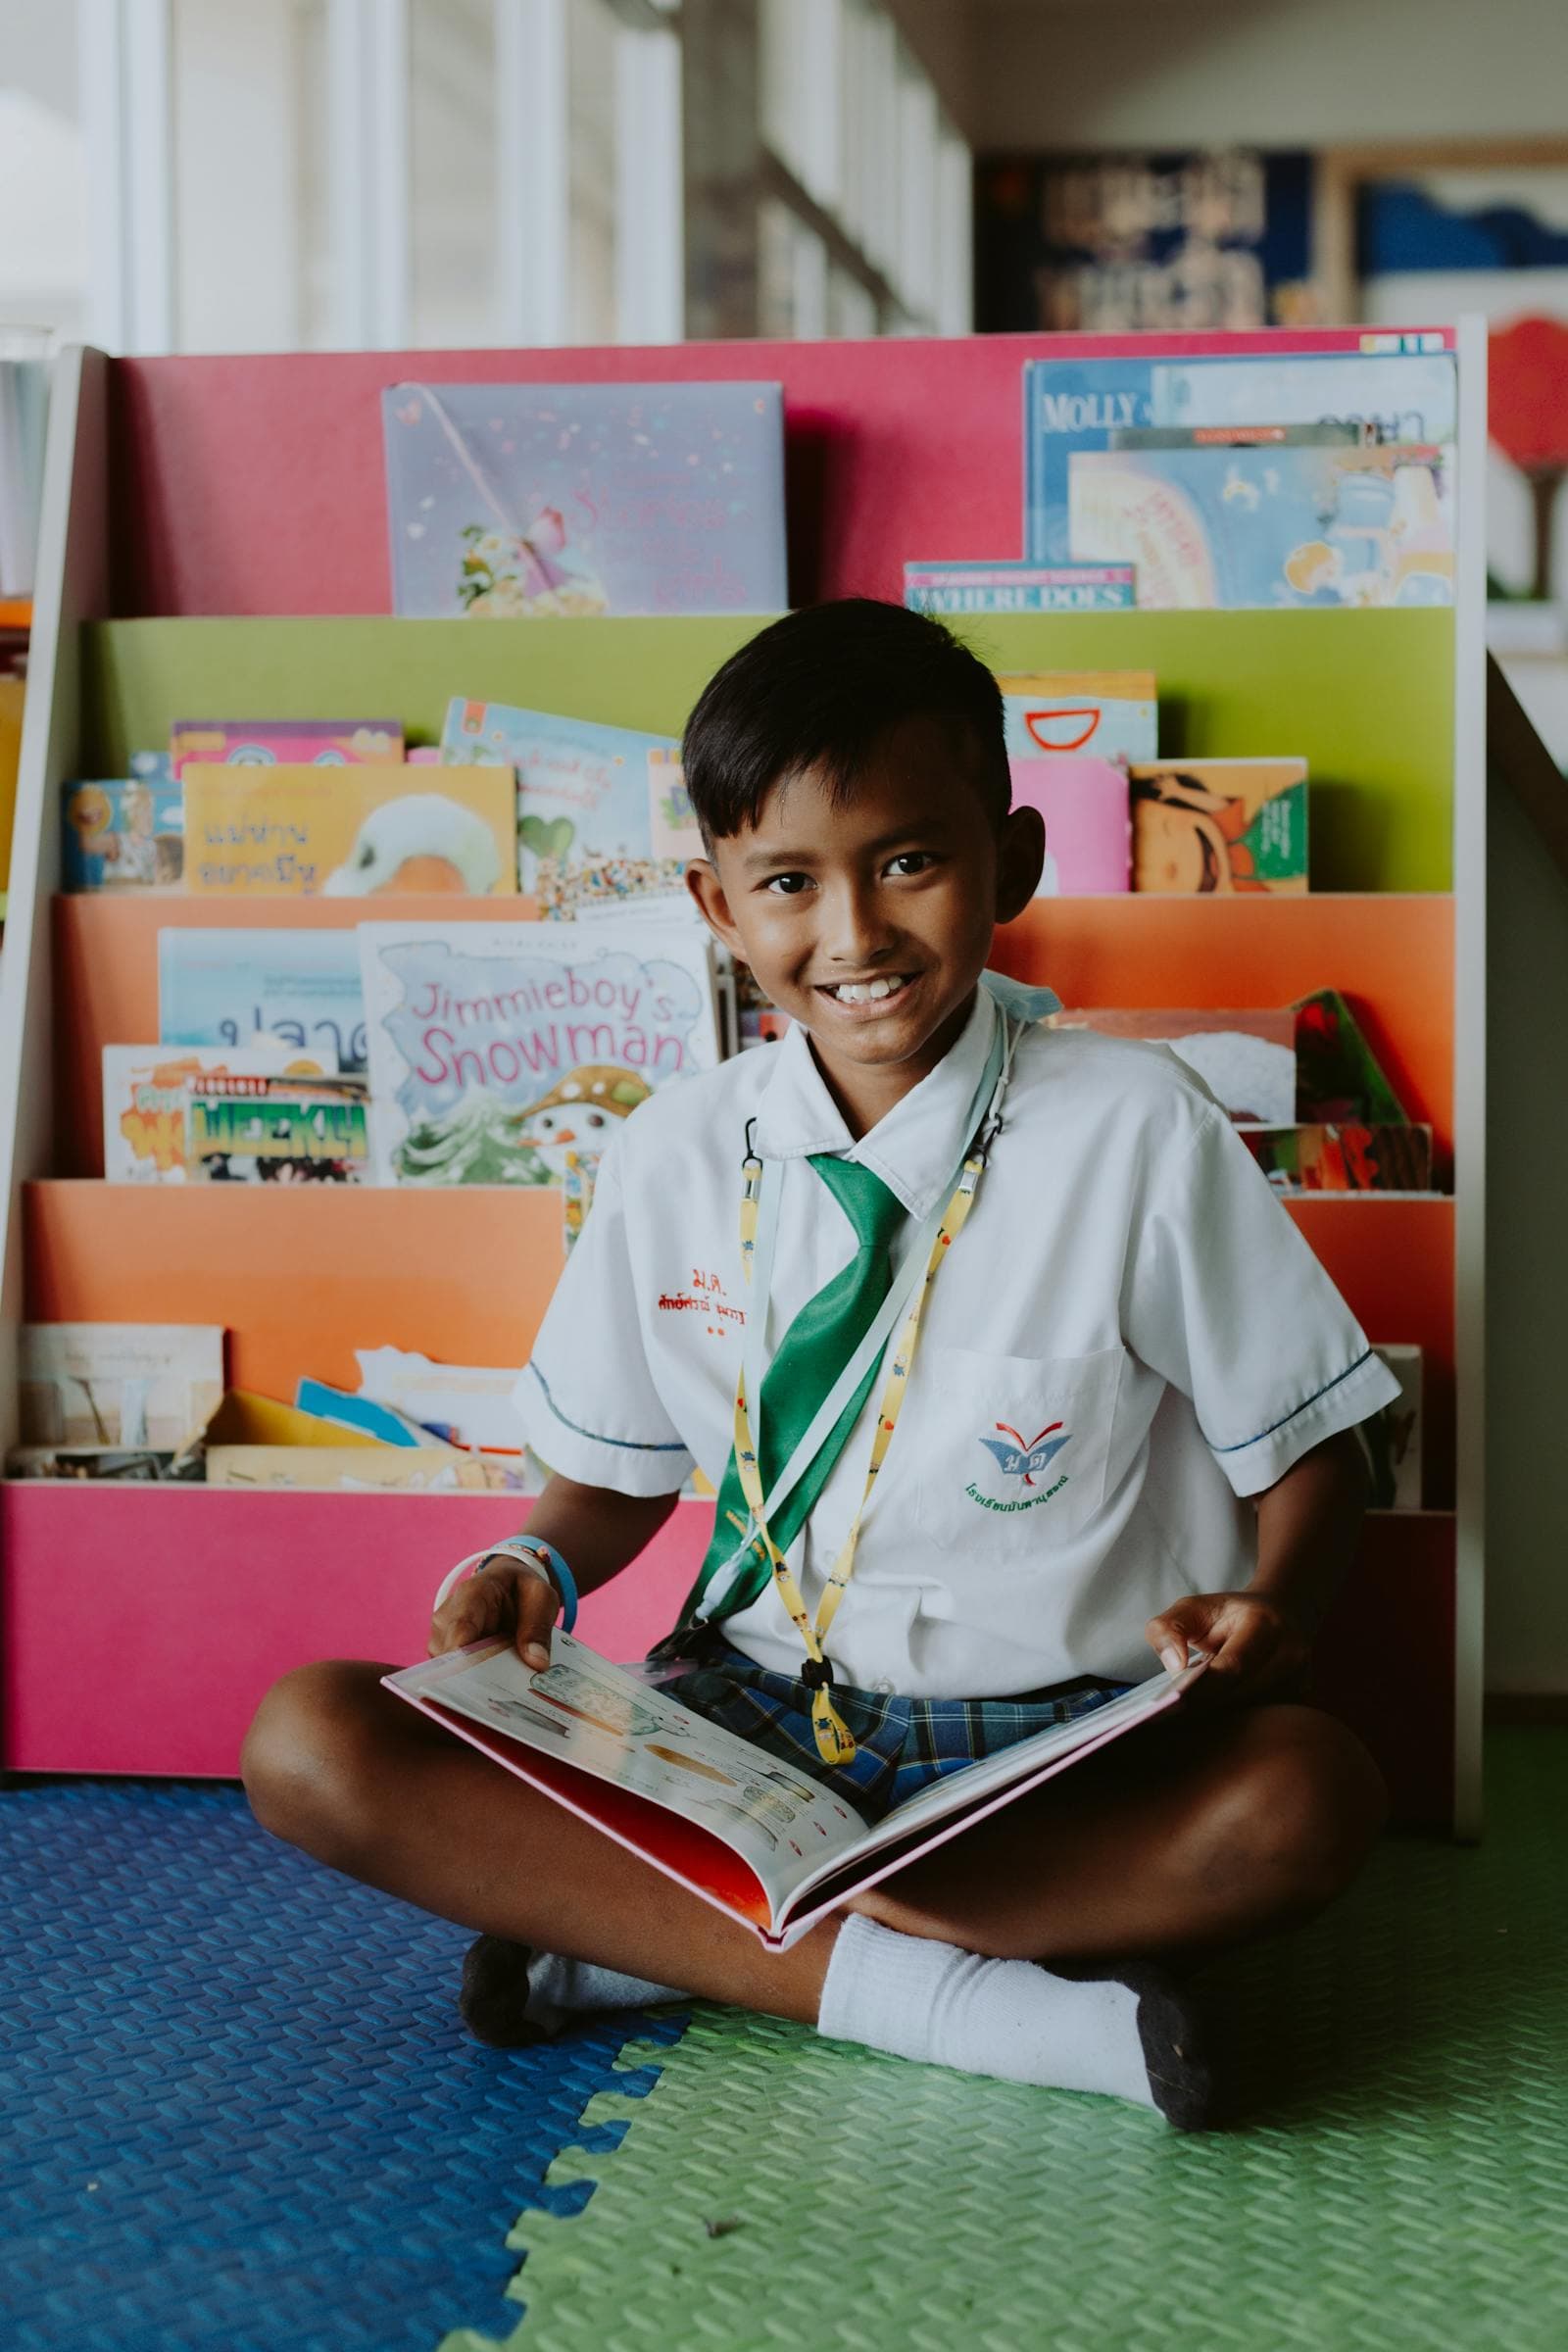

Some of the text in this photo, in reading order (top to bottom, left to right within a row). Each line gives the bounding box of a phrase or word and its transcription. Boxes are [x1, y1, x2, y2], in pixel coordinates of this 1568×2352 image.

[1042, 392, 1138, 433] MOLLY
[911, 585, 1125, 612] WHERE DOES
[413, 967, 676, 1026] Jimmieboy's
[416, 1022, 685, 1088] Snowman
